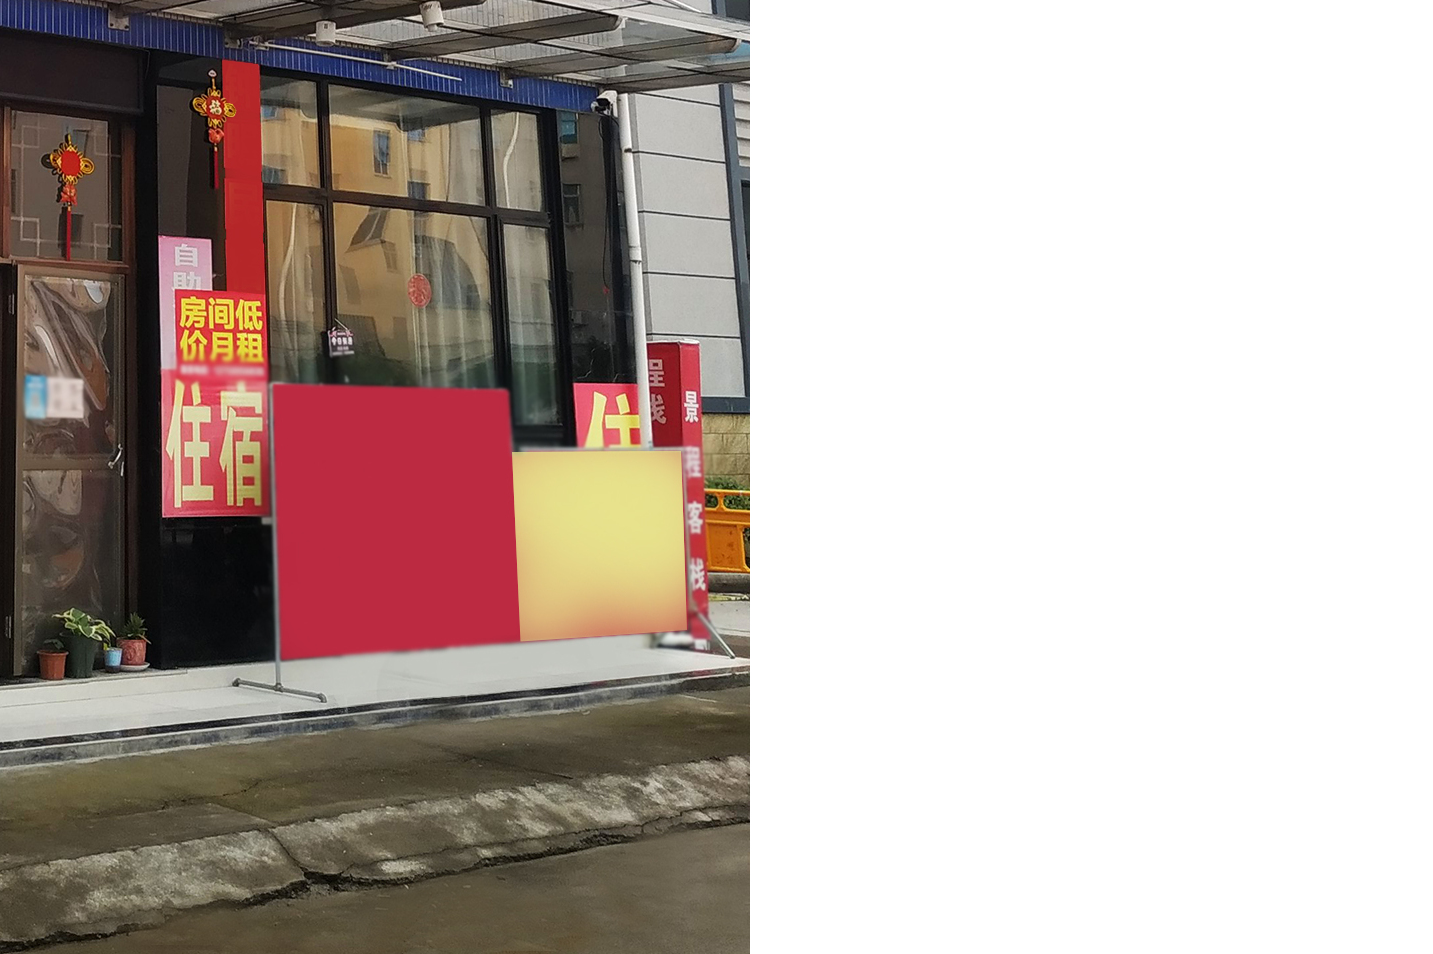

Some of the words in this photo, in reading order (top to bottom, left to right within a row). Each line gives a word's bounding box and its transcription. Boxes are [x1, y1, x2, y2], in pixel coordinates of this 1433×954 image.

[179, 296, 264, 331] 房间低
[179, 330, 265, 363] 价月租
[165, 379, 264, 509] 住宿
